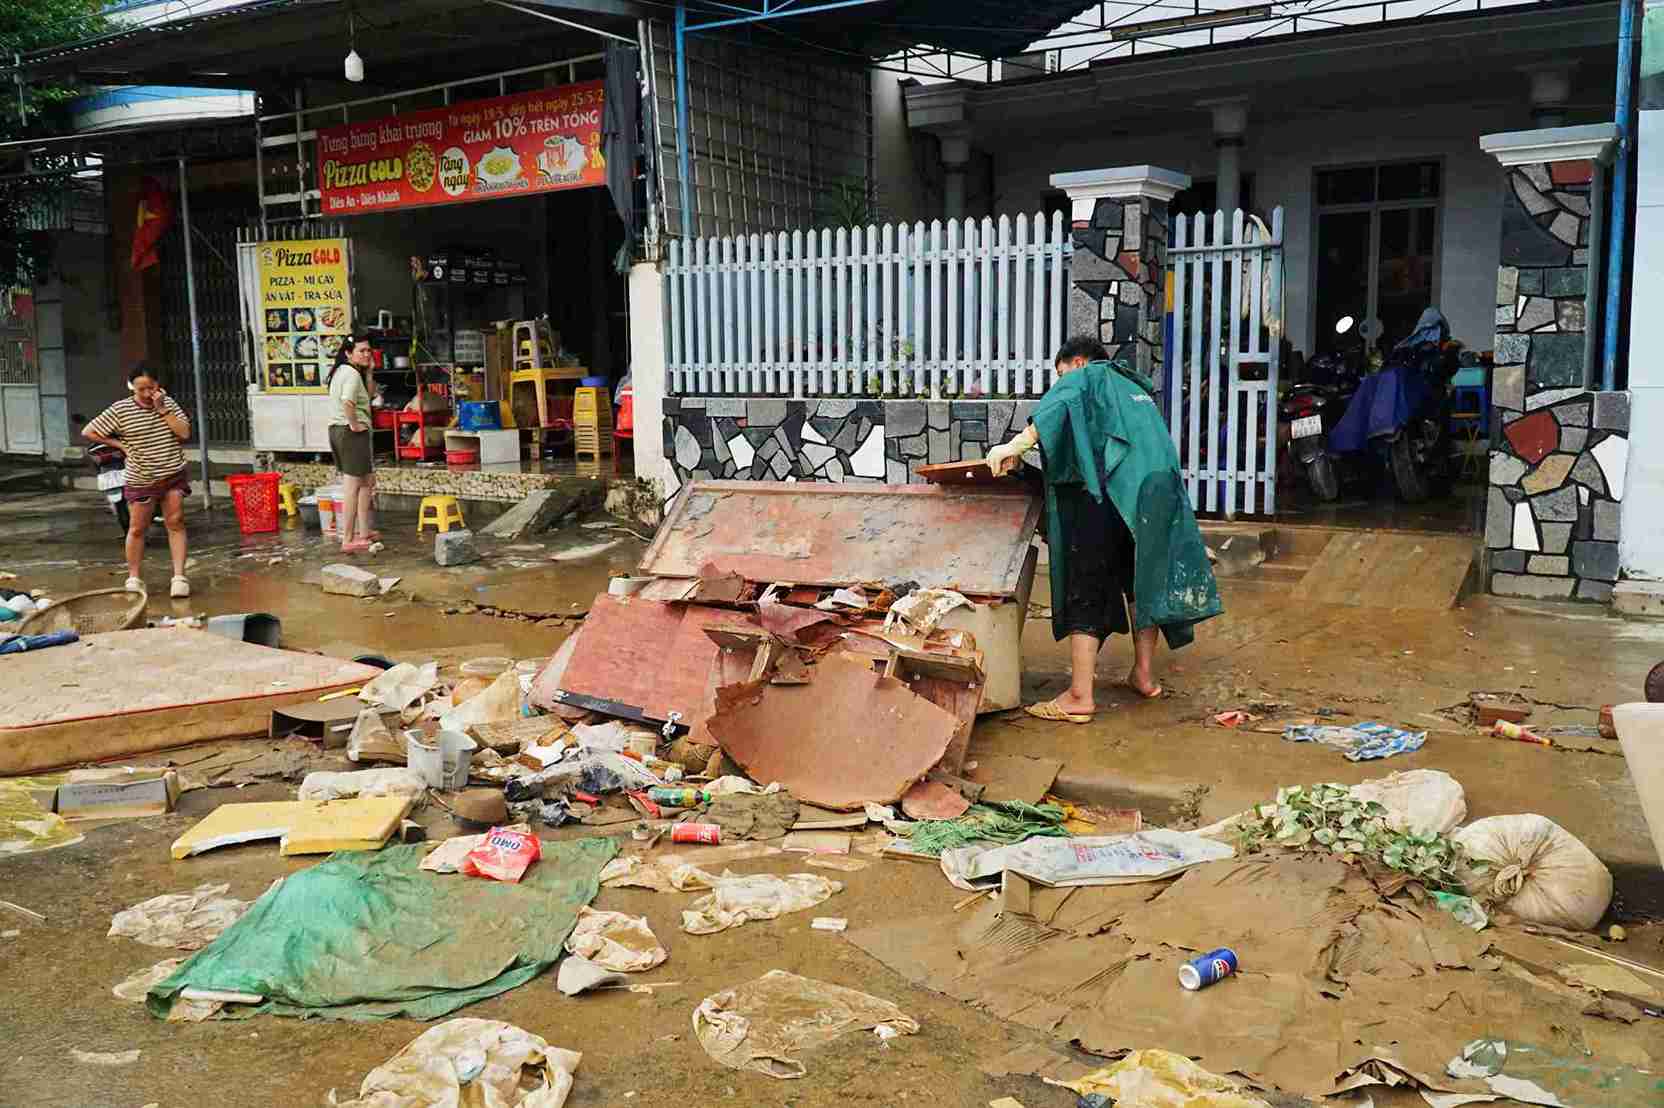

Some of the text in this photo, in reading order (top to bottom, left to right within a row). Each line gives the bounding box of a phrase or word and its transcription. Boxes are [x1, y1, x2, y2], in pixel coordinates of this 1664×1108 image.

[494, 115, 528, 140] 10%
[323, 157, 403, 190] Pizza GOLD
[275, 247, 341, 267] Pizza GOLD
[269, 276, 295, 286] PIZZA
